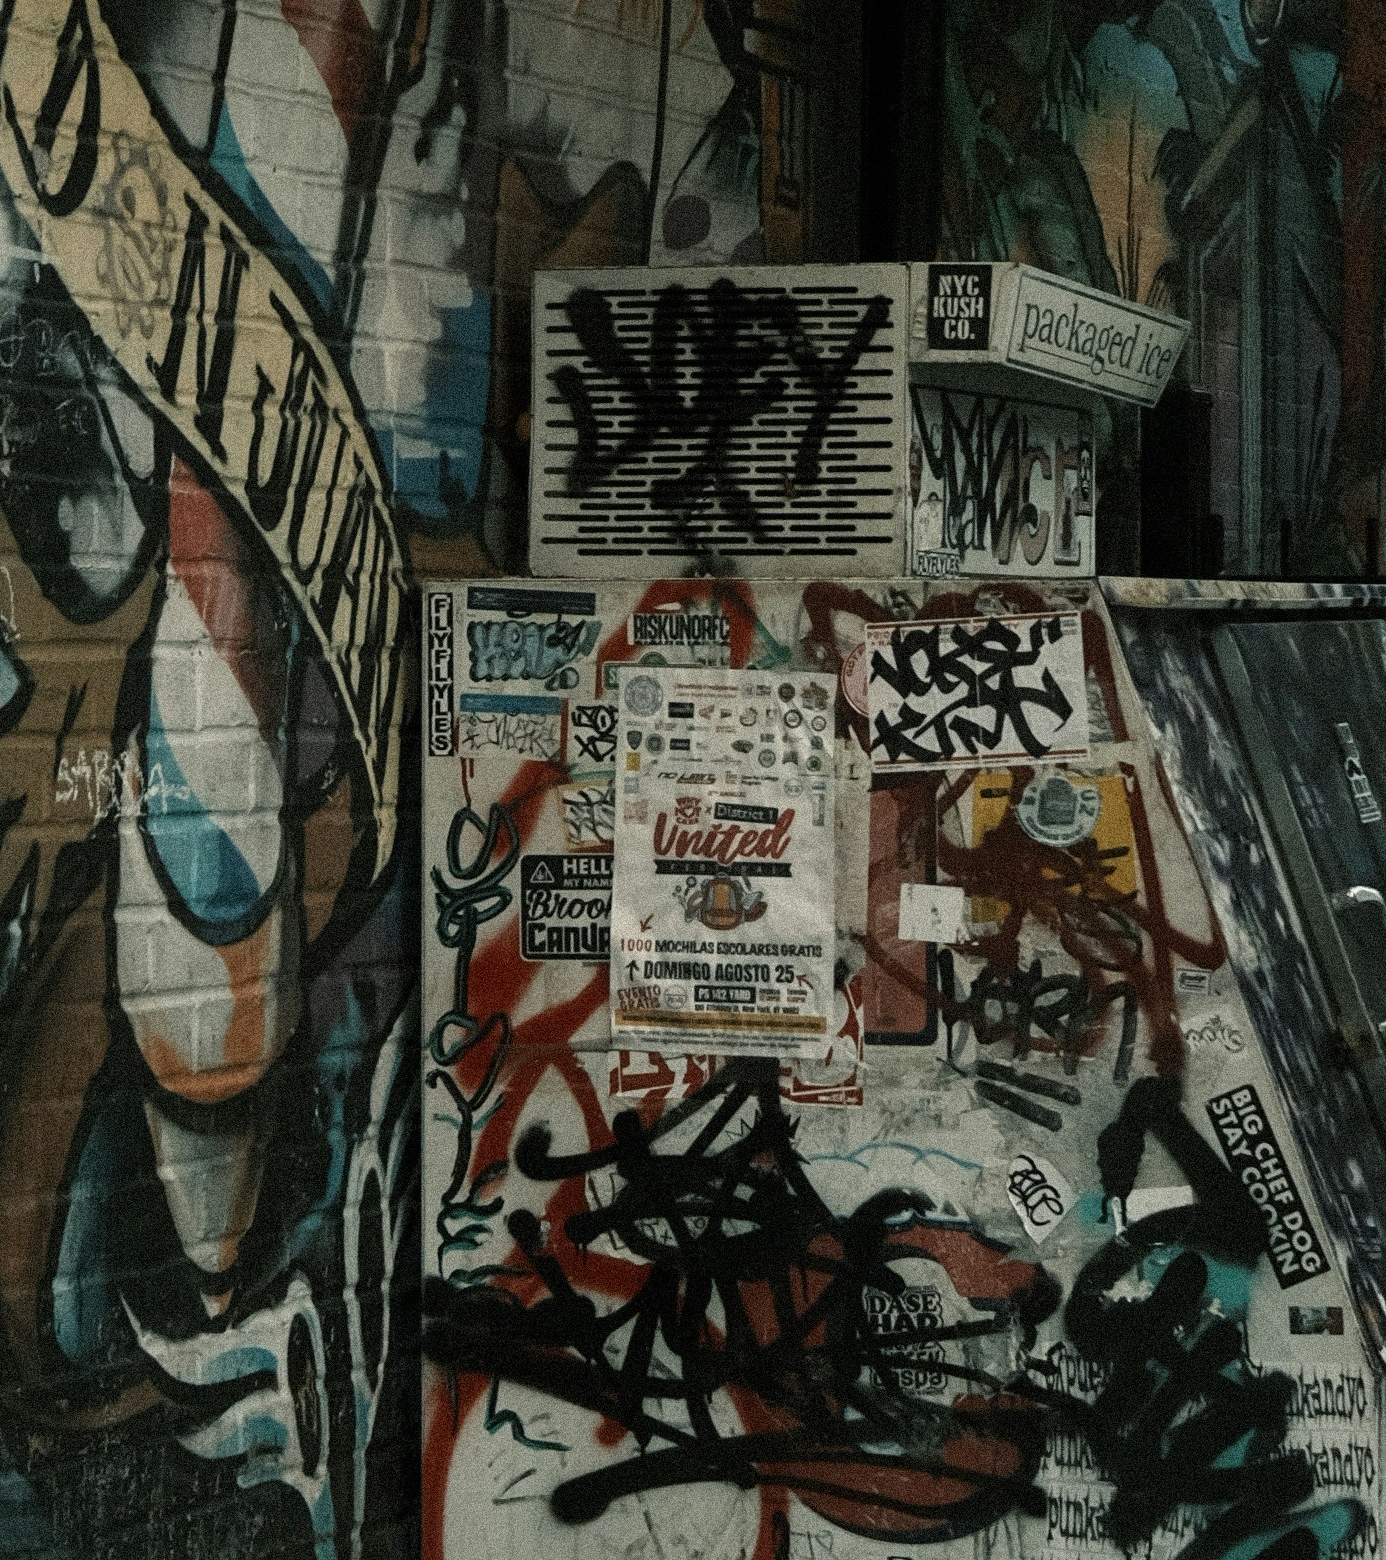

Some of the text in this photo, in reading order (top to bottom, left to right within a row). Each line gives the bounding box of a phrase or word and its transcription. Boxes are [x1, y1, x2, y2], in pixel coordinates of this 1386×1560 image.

[937, 274, 981, 297] NYC
[932, 296, 985, 318] KUSH
[942, 318, 976, 340] CO.
[1017, 301, 1174, 381] packaged ice
[716, 803, 763, 820] District
[653, 808, 797, 865] United
[619, 938, 652, 952] 1000
[654, 940, 715, 955] MOCHILAS
[643, 961, 795, 984] DOMINGO AGOSTO 25
[1211, 1097, 1252, 1158] STAY
[1231, 1088, 1321, 1273] BIG CHEF DOG
